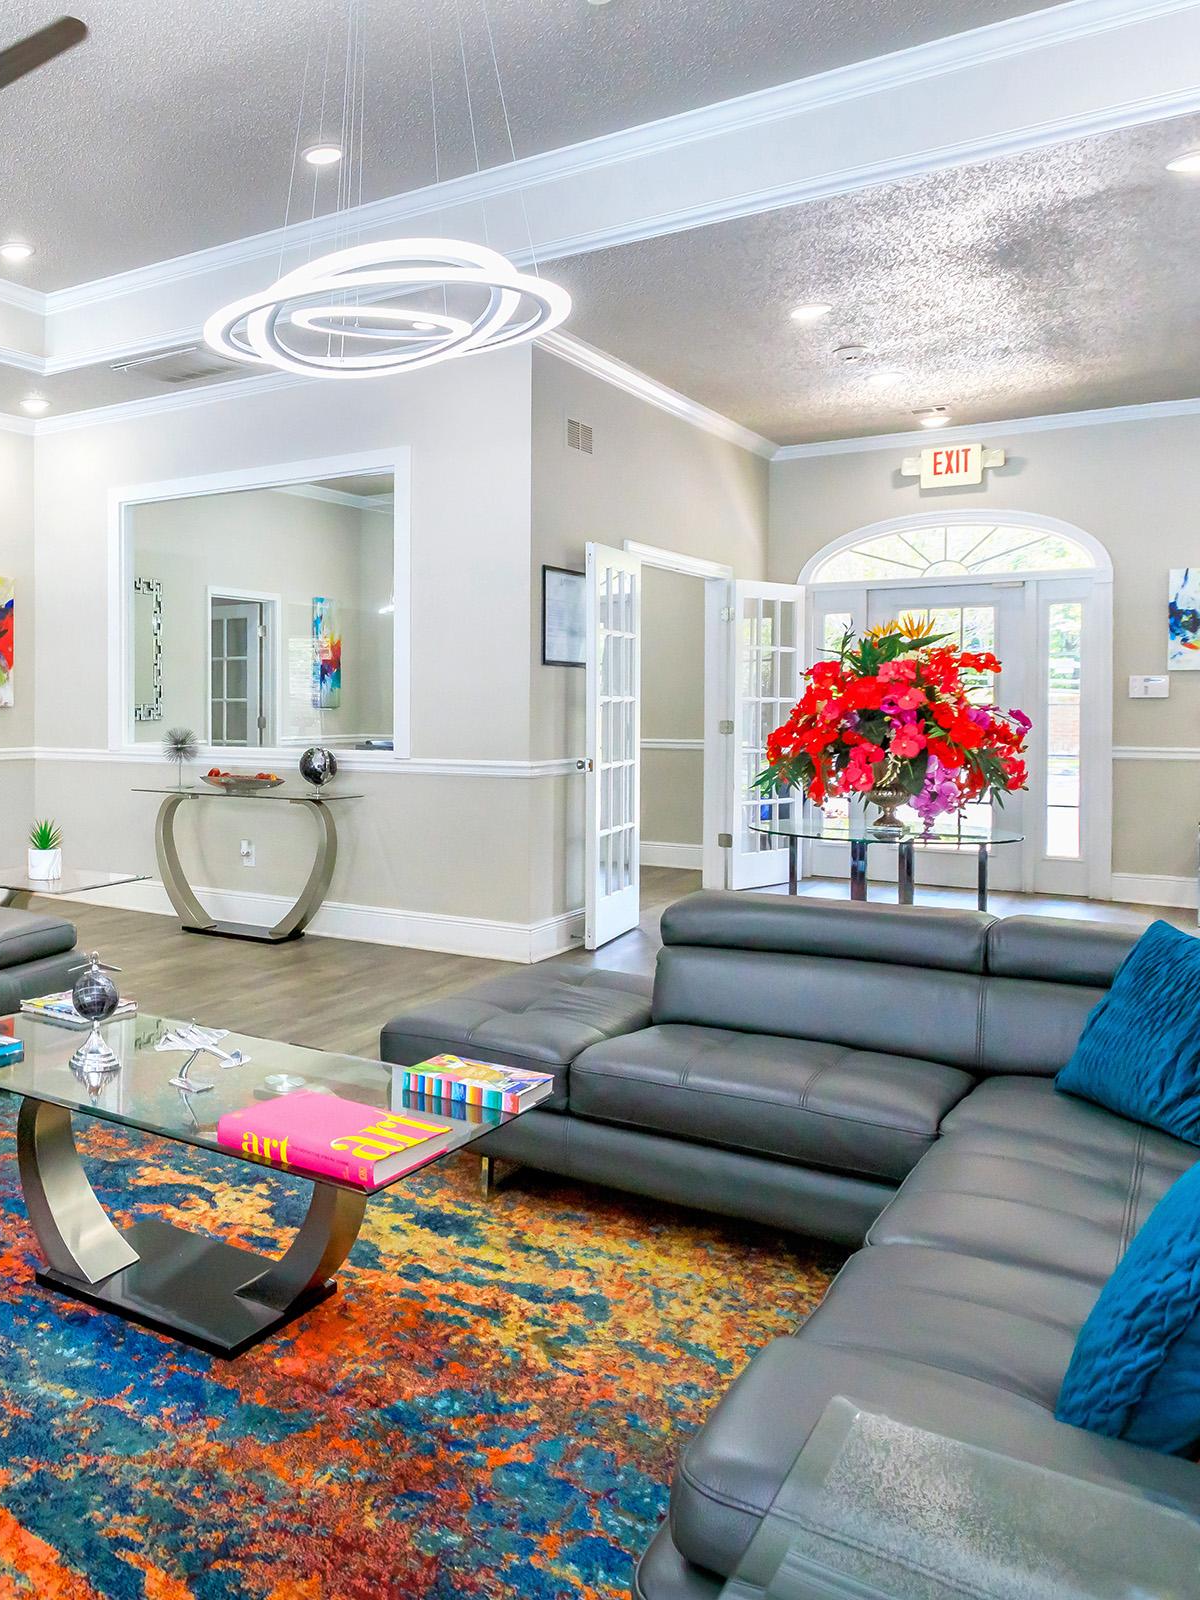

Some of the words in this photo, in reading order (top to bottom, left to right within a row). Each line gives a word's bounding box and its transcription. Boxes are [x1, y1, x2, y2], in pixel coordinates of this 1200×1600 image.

[933, 448, 971, 475] EXIT
[241, 1131, 291, 1165] art
[330, 1110, 453, 1161] art
